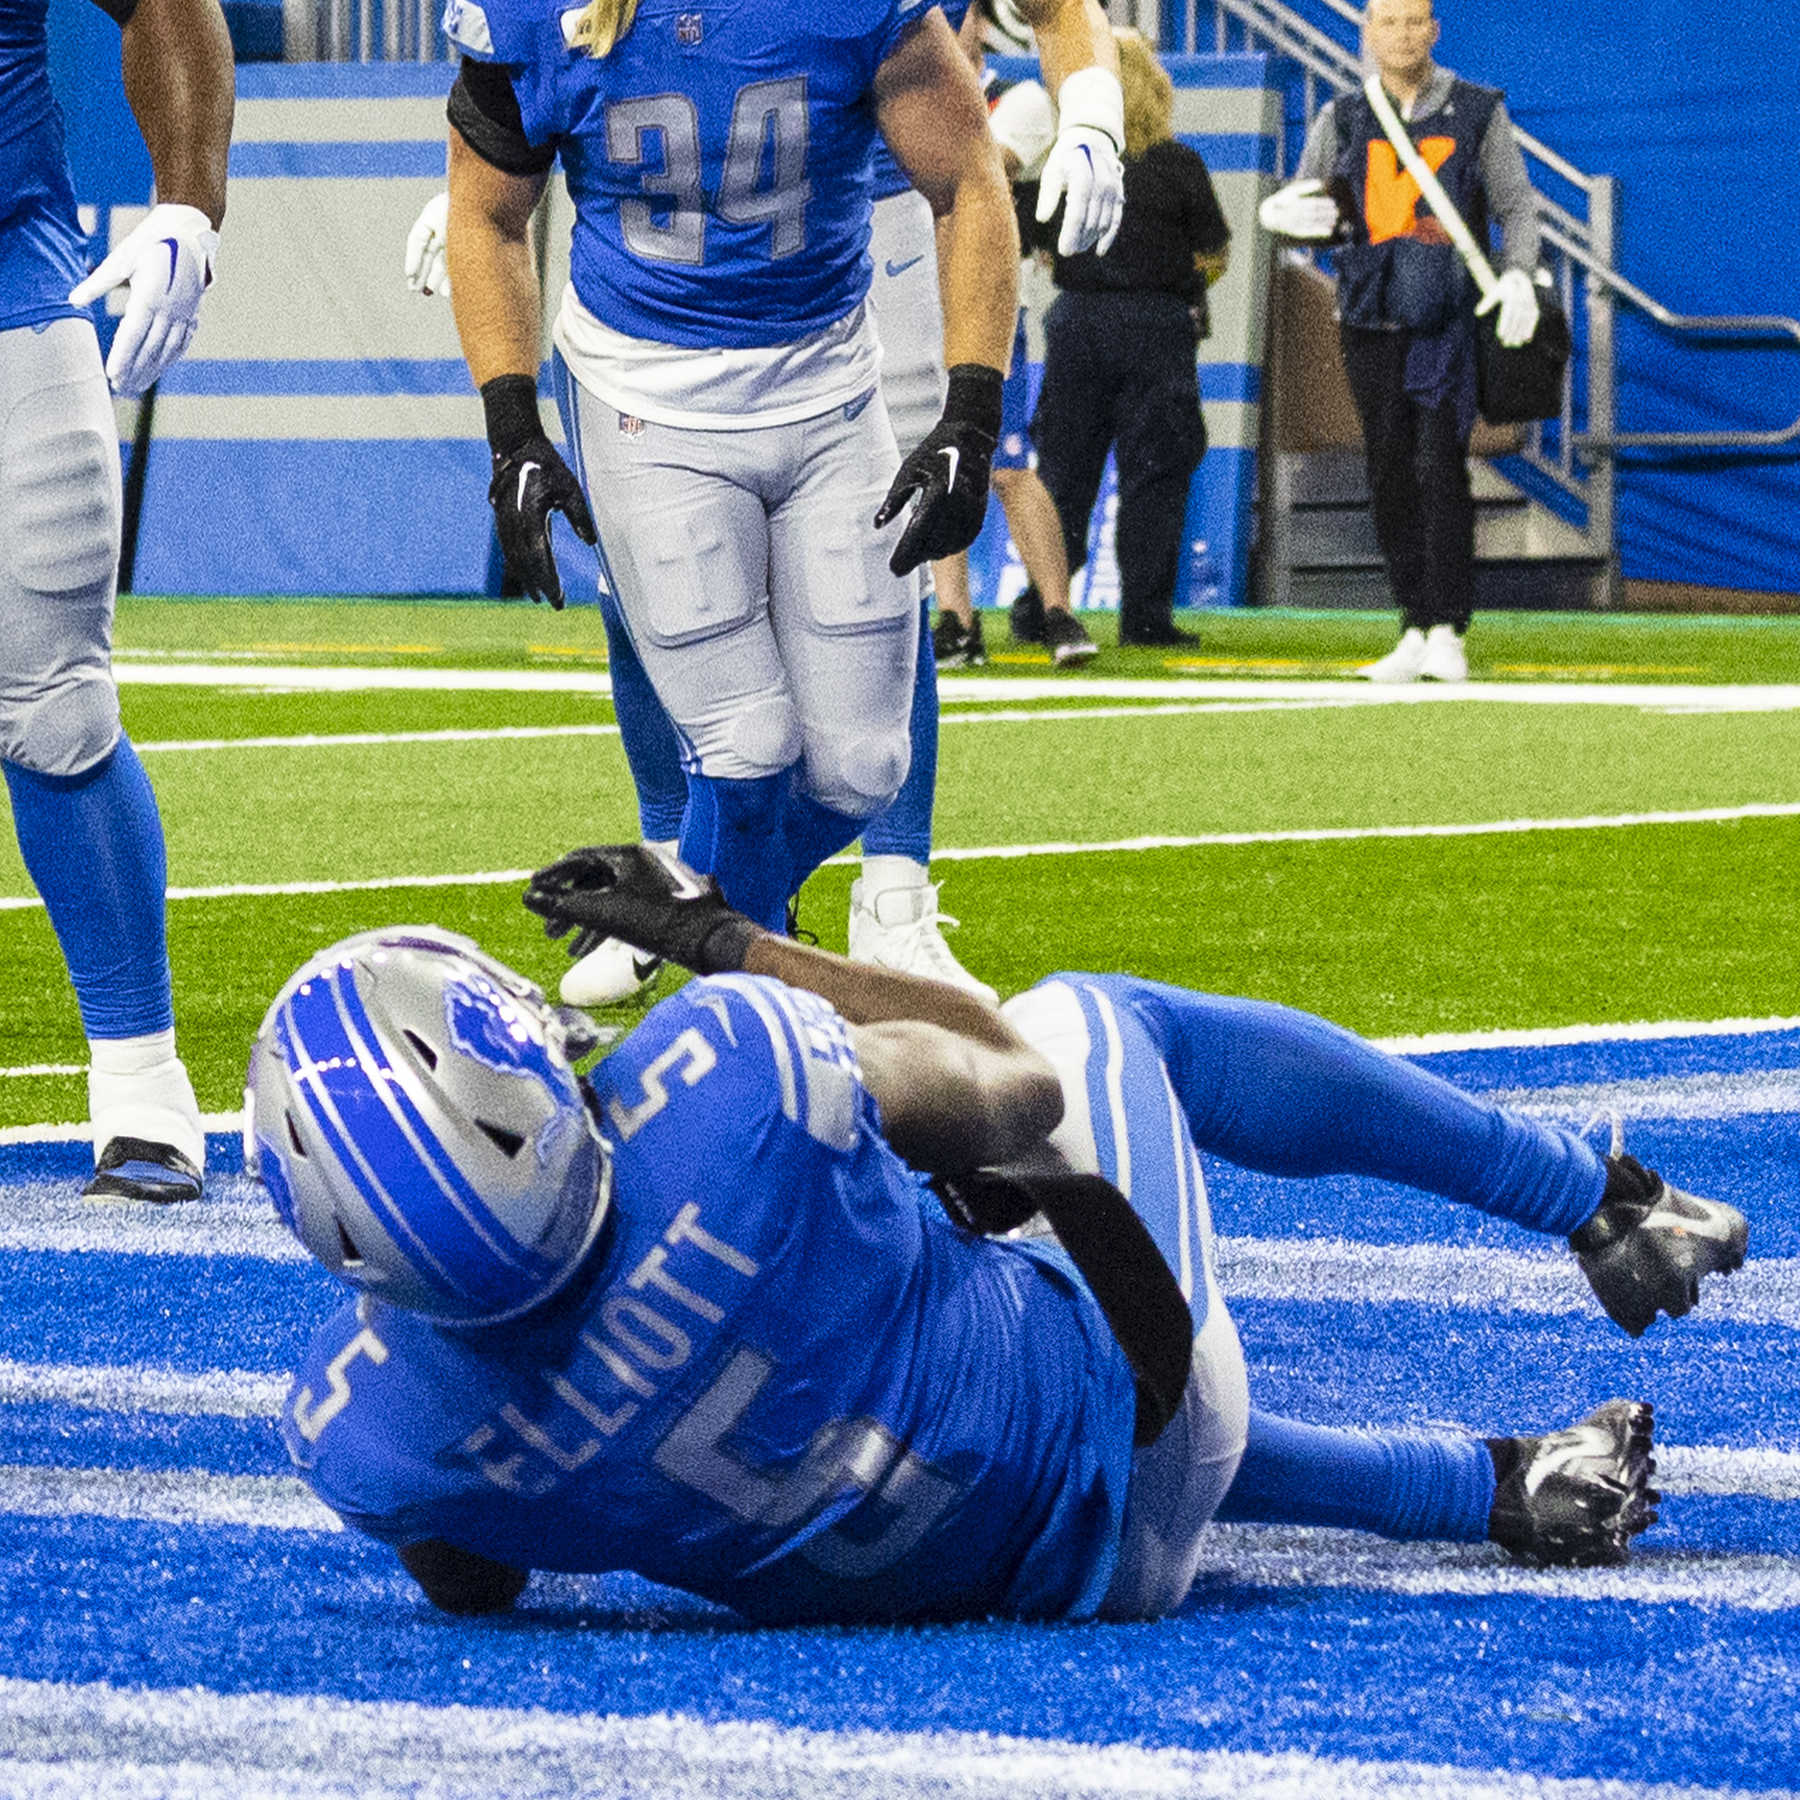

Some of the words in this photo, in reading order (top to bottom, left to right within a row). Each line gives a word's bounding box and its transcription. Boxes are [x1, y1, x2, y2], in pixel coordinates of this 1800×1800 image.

[607, 72, 813, 268] 34
[611, 1025, 716, 1140] 5
[296, 1324, 387, 1442] 5
[460, 1201, 759, 1496] ELLIOTT
[652, 1343, 966, 1578] 5
